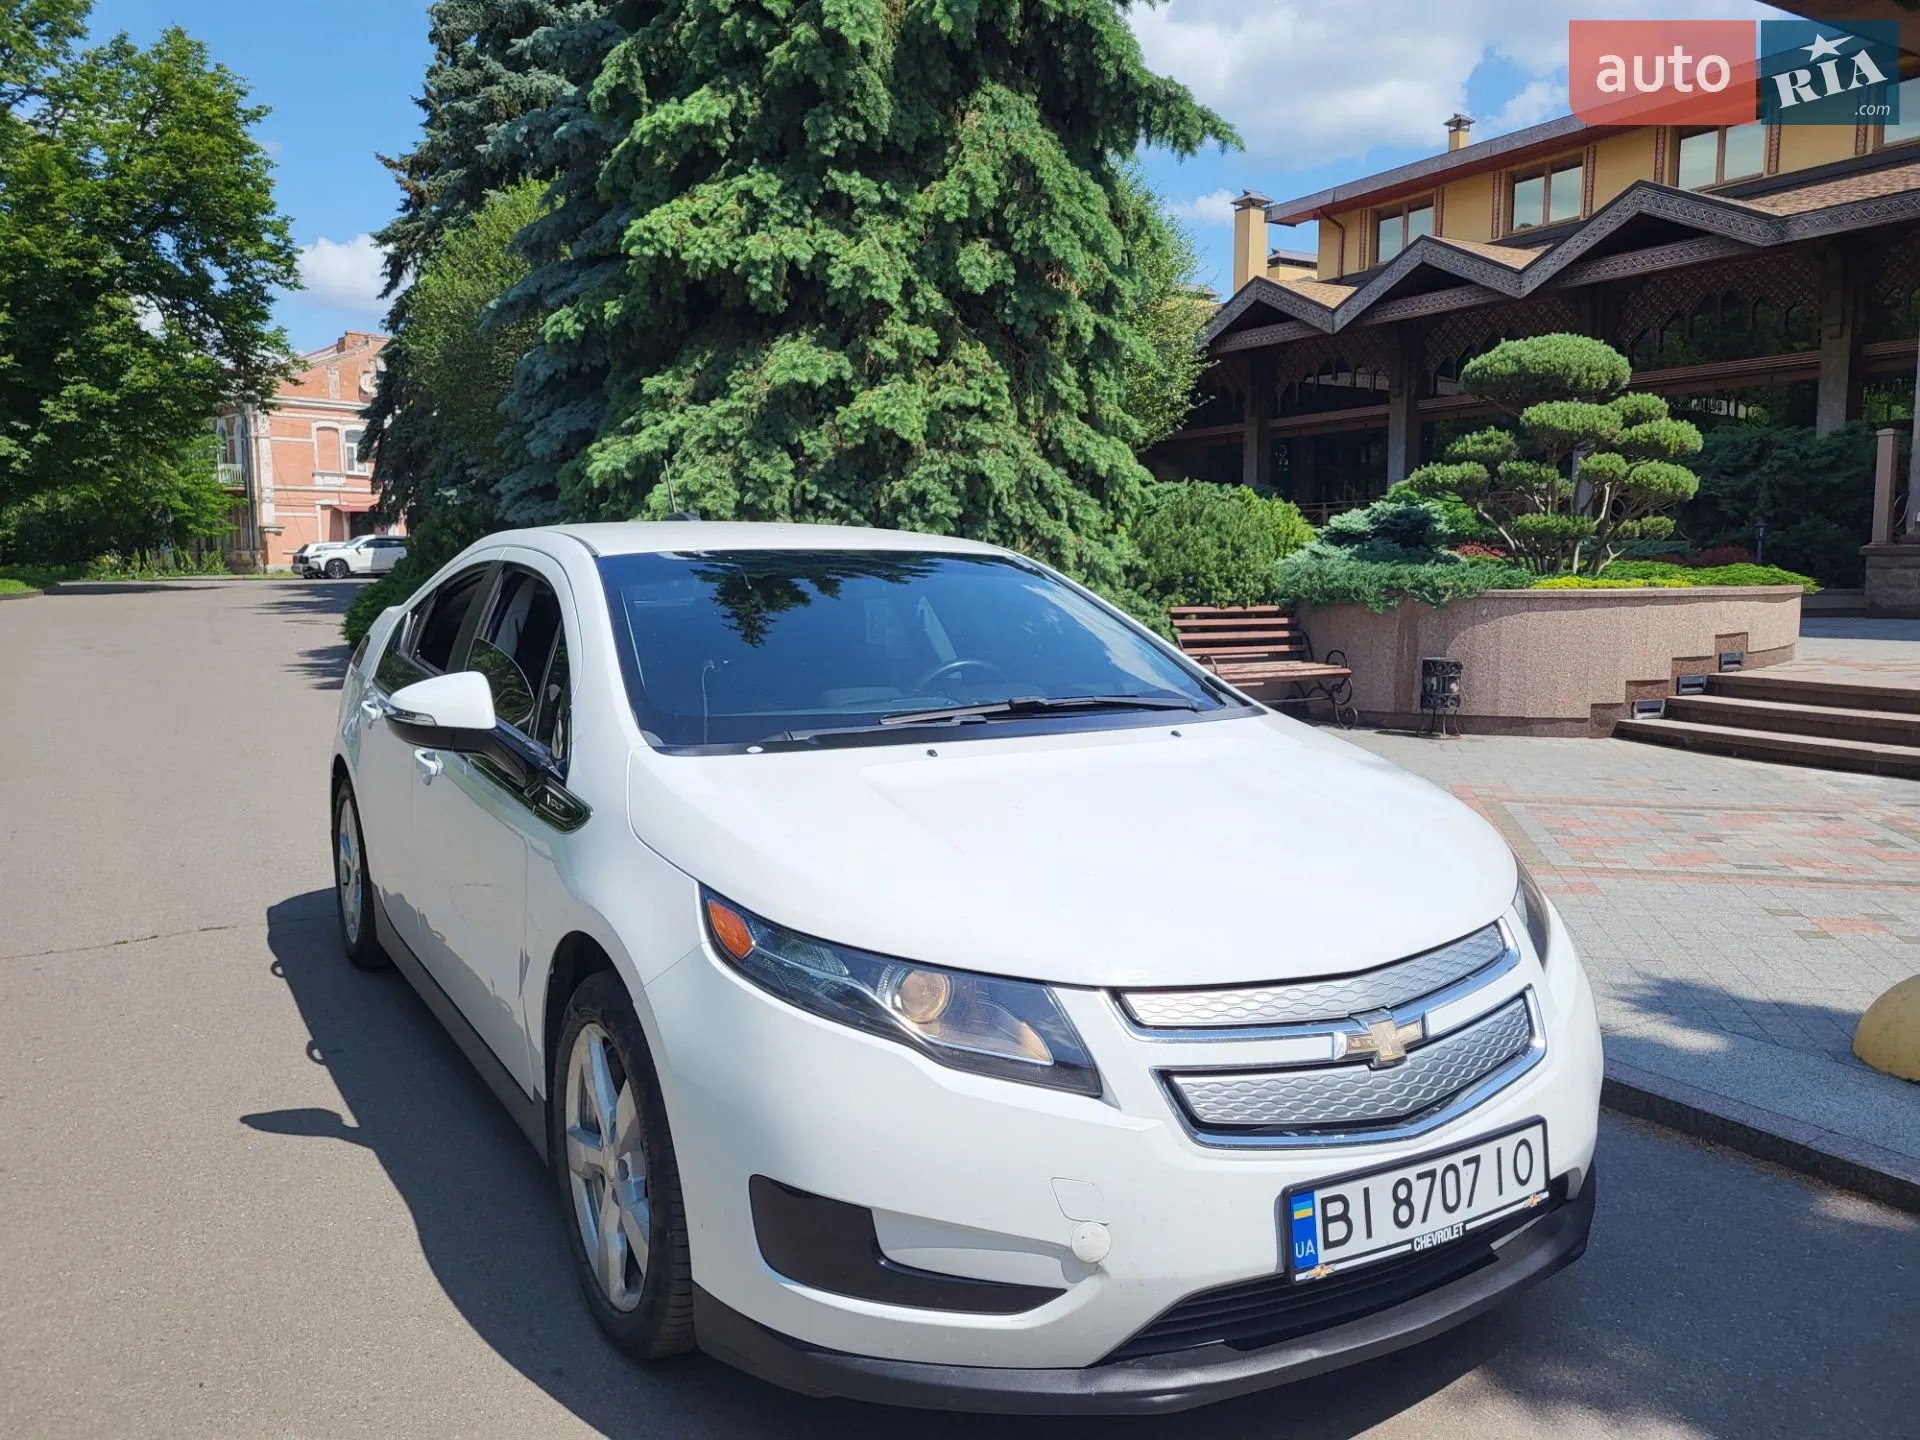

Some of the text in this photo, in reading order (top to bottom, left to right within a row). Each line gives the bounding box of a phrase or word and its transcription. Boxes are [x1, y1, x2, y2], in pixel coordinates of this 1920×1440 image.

[1320, 1138, 1534, 1251] BI 8707 IO
[1295, 1239, 1316, 1259] UA
[1413, 1222, 1464, 1252] CHEVROLET
